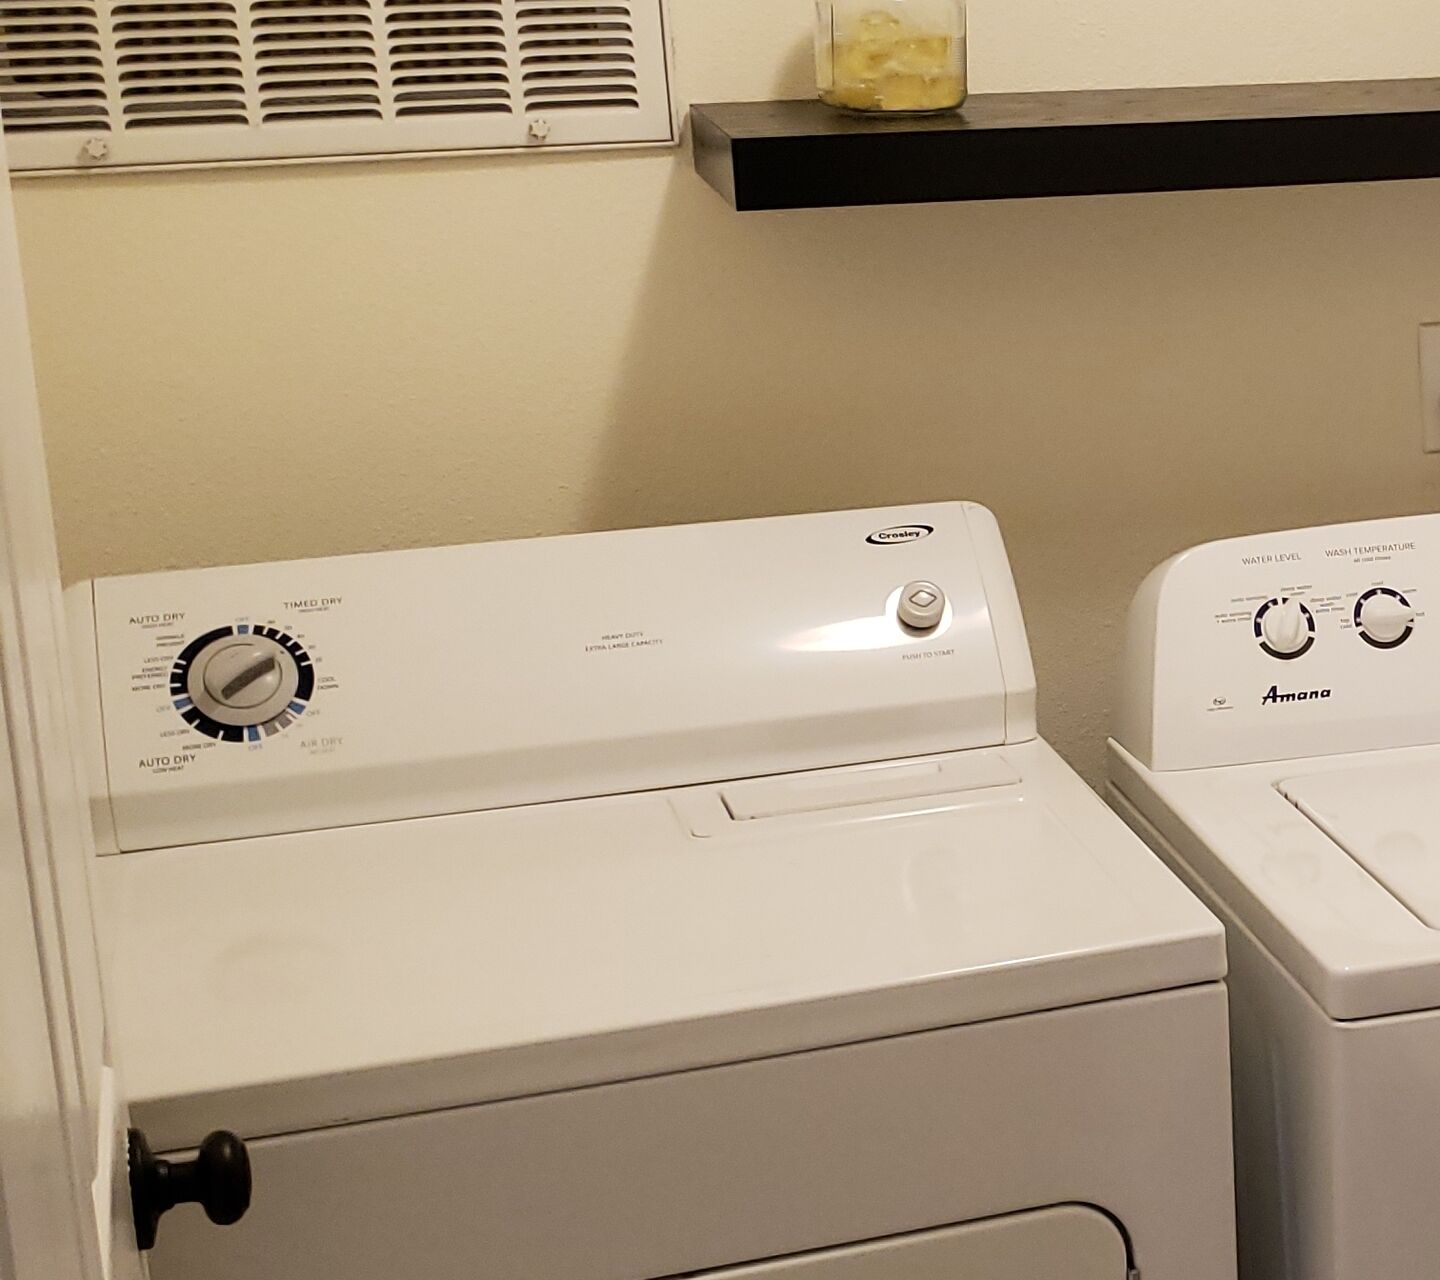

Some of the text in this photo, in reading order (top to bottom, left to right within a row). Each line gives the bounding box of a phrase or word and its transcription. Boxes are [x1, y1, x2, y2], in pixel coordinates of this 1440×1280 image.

[878, 530, 921, 540] Crosley
[1325, 542, 1416, 557] WASH TEMPERATURE
[1241, 552, 1303, 566] WATER LEVEL
[283, 597, 343, 609] TIMED DRY
[129, 612, 186, 624] AUTO DRY
[1262, 685, 1331, 705] Amana
[139, 753, 197, 768] AUTO DRY
